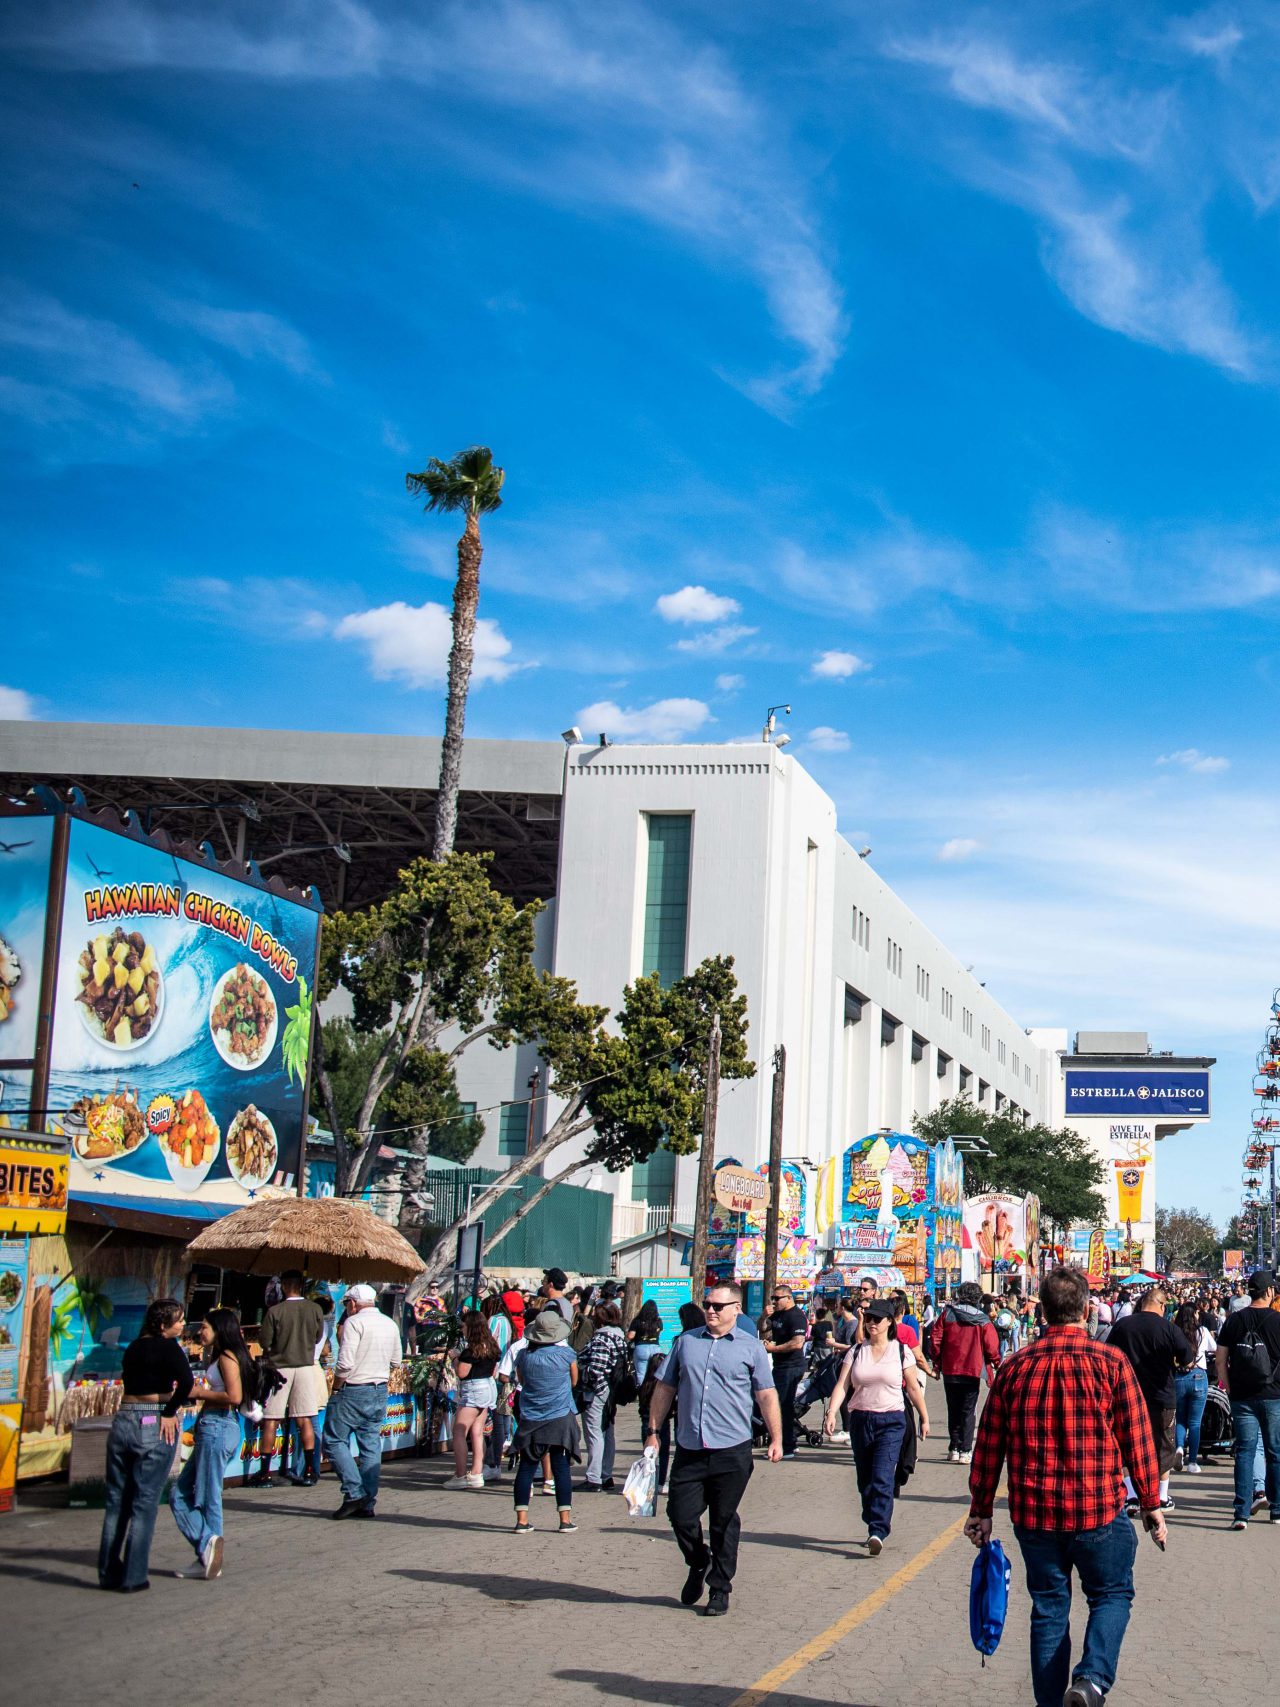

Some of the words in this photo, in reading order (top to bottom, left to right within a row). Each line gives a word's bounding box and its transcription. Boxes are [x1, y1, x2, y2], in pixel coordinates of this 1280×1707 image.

[85, 884, 181, 923] HAWAIIAN
[183, 891, 251, 944] CHICKEN
[250, 924, 297, 983] BOWLS
[1070, 1088, 1136, 1098] ESTRELLA
[1151, 1089, 1205, 1099] JALISCO
[150, 1105, 172, 1127] Spicy
[1109, 1132, 1151, 1140] ESTRELLA!
[0, 1163, 55, 1197] BITES
[720, 1171, 765, 1200] LONGBOARD
[857, 1186, 882, 1200] DOL
